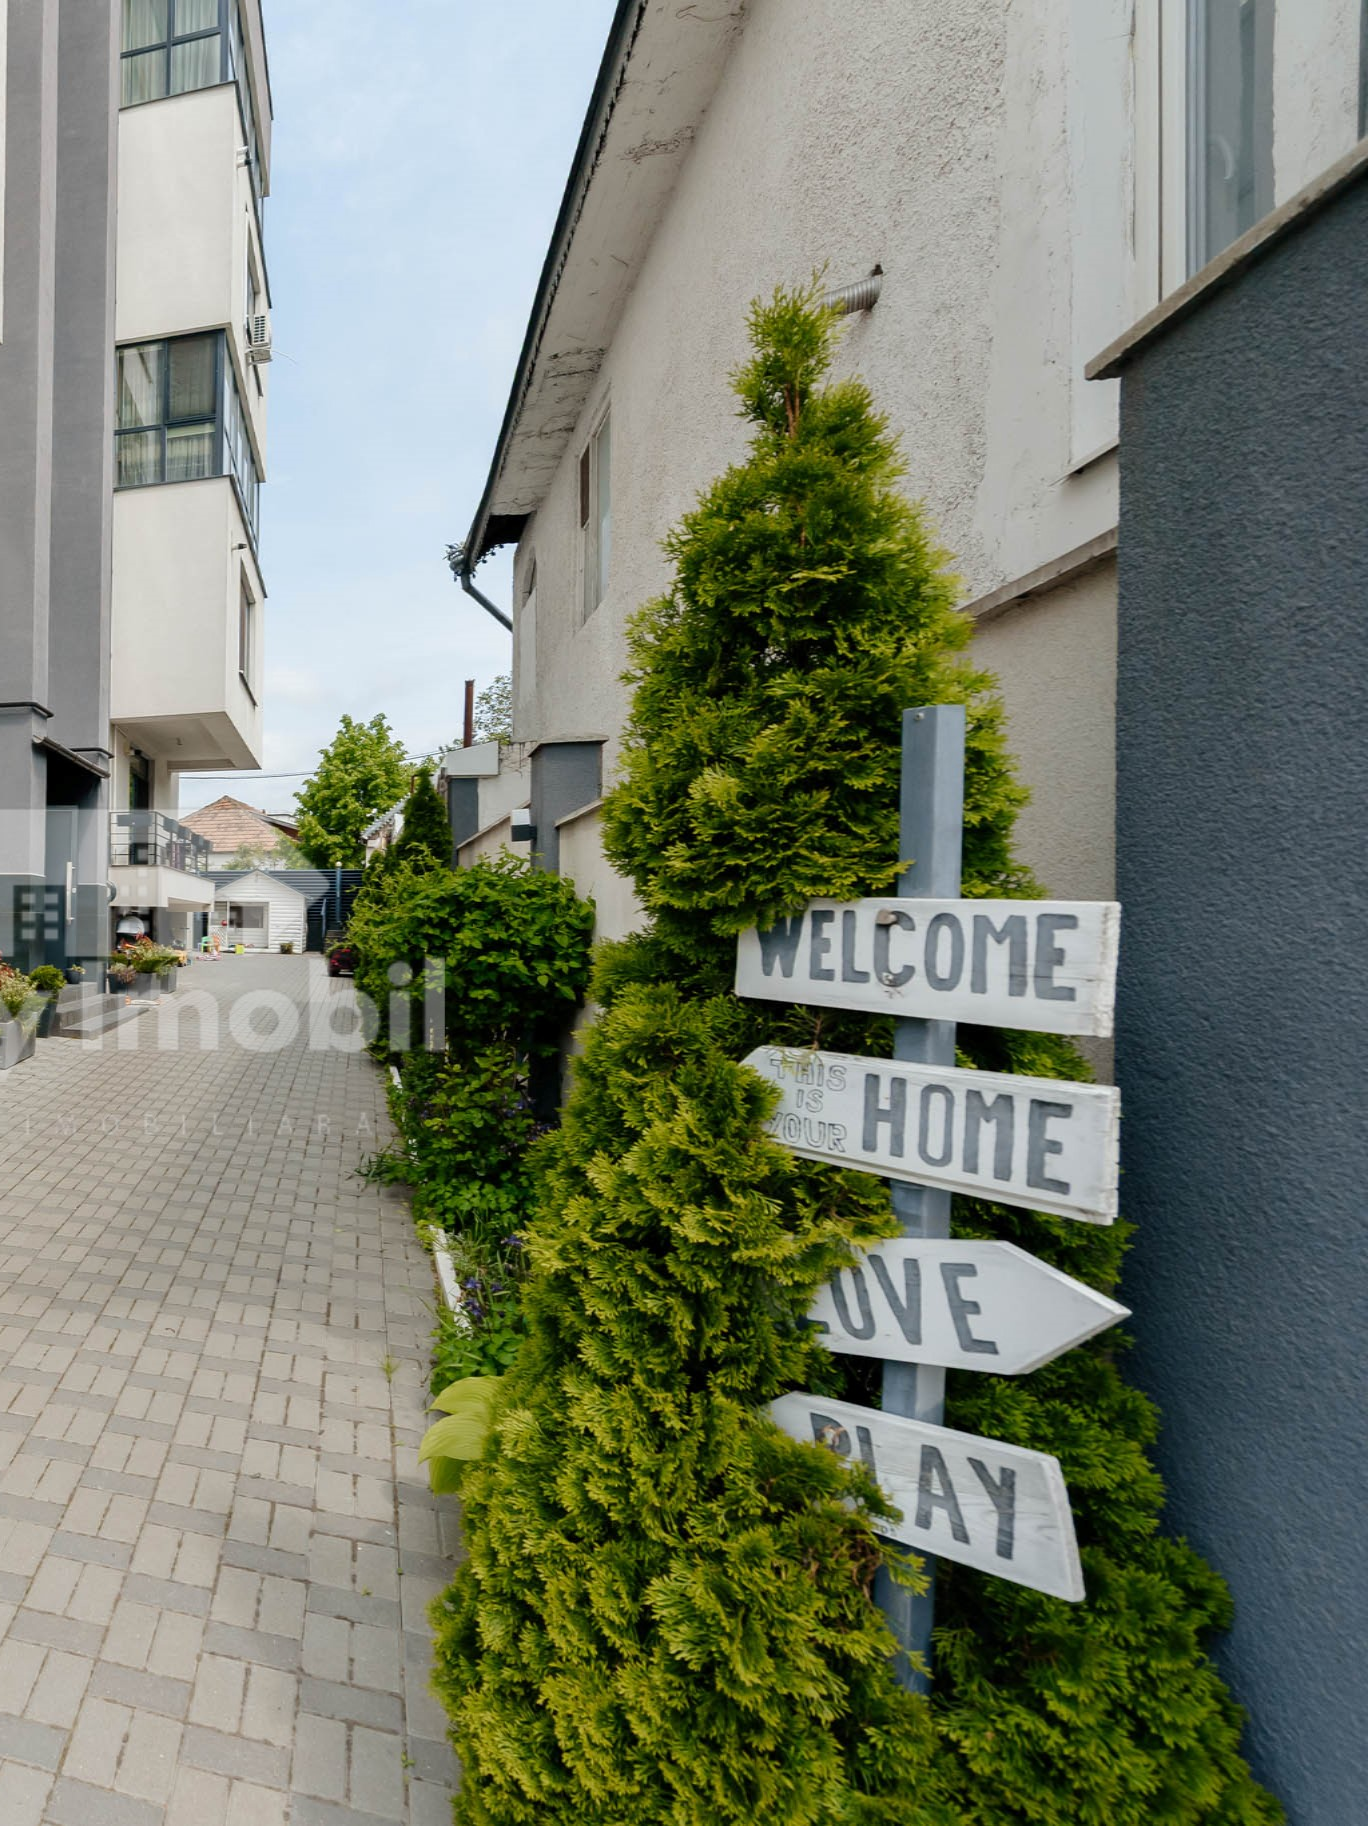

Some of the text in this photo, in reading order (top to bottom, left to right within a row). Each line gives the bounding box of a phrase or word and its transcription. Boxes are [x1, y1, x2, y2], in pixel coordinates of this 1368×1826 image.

[756, 908, 1079, 1001] WELCOME
[770, 1059, 847, 1092] THIS
[796, 1089, 823, 1113] IS
[862, 1073, 1073, 1195] HOME
